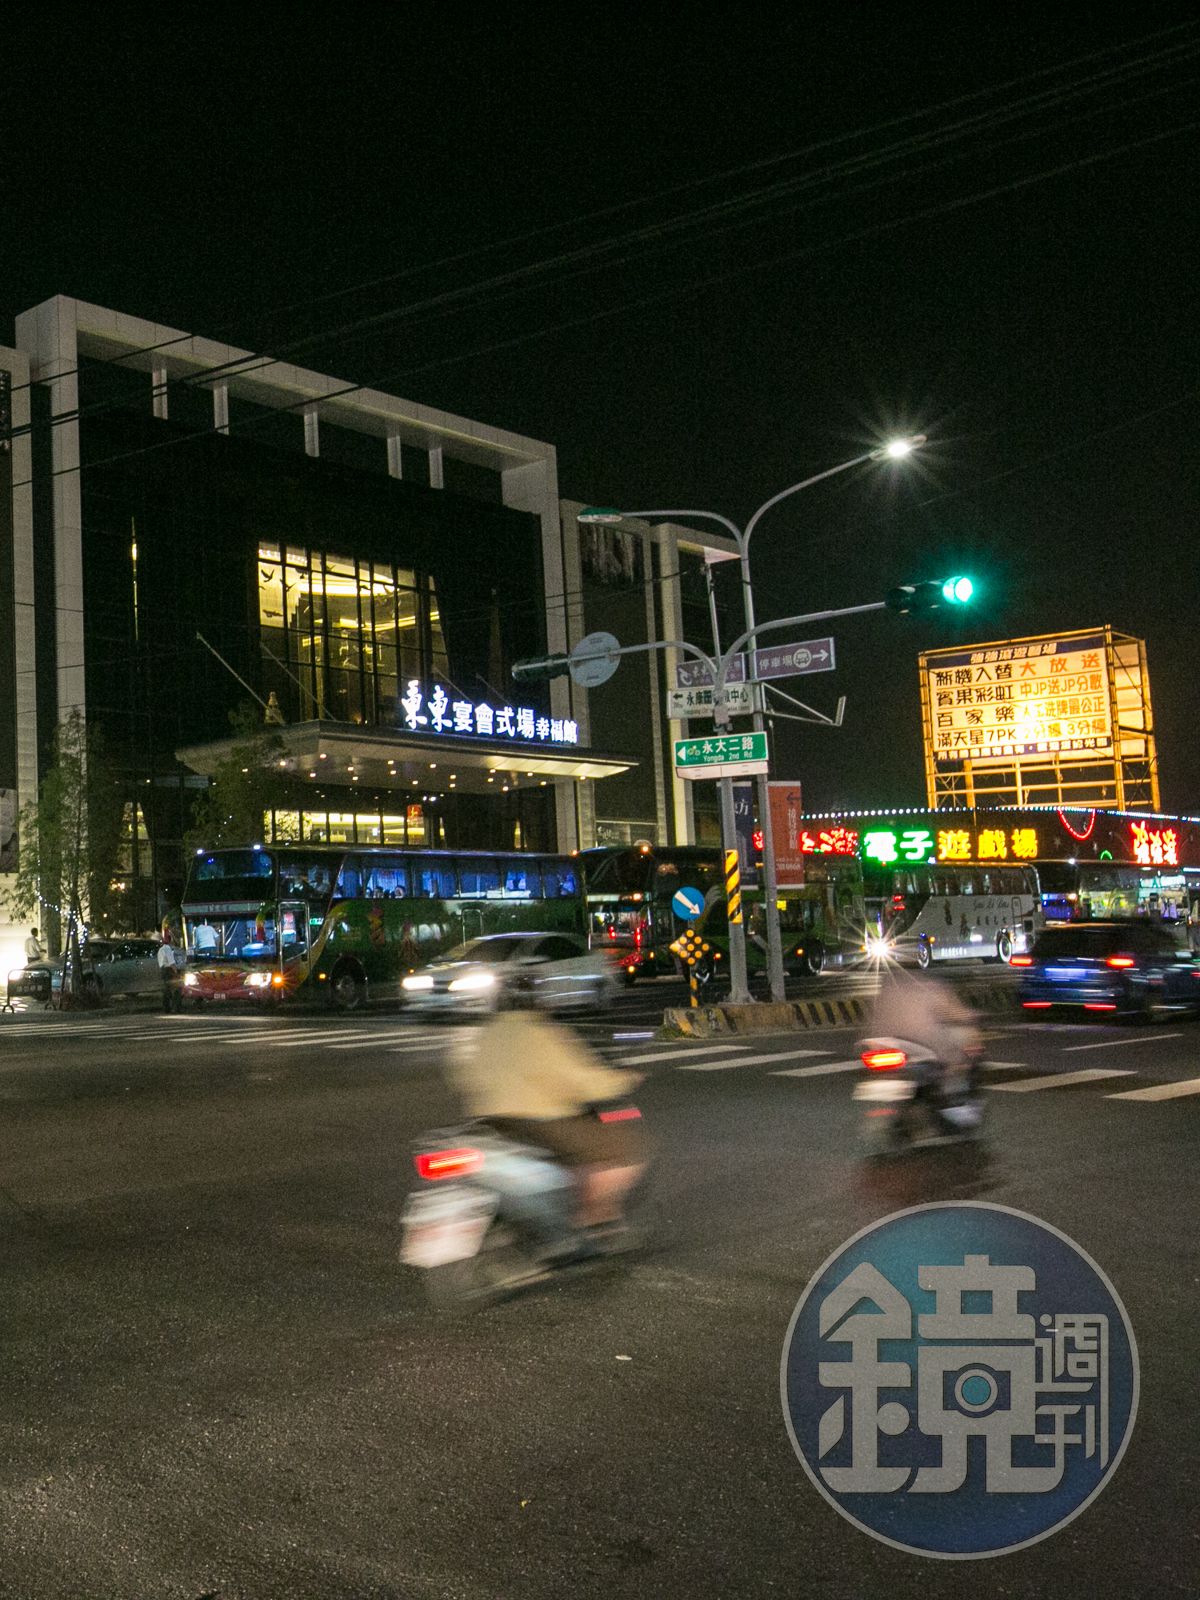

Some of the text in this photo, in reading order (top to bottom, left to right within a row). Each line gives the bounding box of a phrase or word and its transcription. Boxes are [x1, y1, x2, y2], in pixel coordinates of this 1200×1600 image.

[759, 654, 793, 670] 停車場
[936, 652, 1100, 686] 新機入替 大放送
[936, 705, 1015, 728] 百家樂
[702, 736, 754, 754] 永大二路
[703, 751, 753, 764] Yongda 2nd Rd
